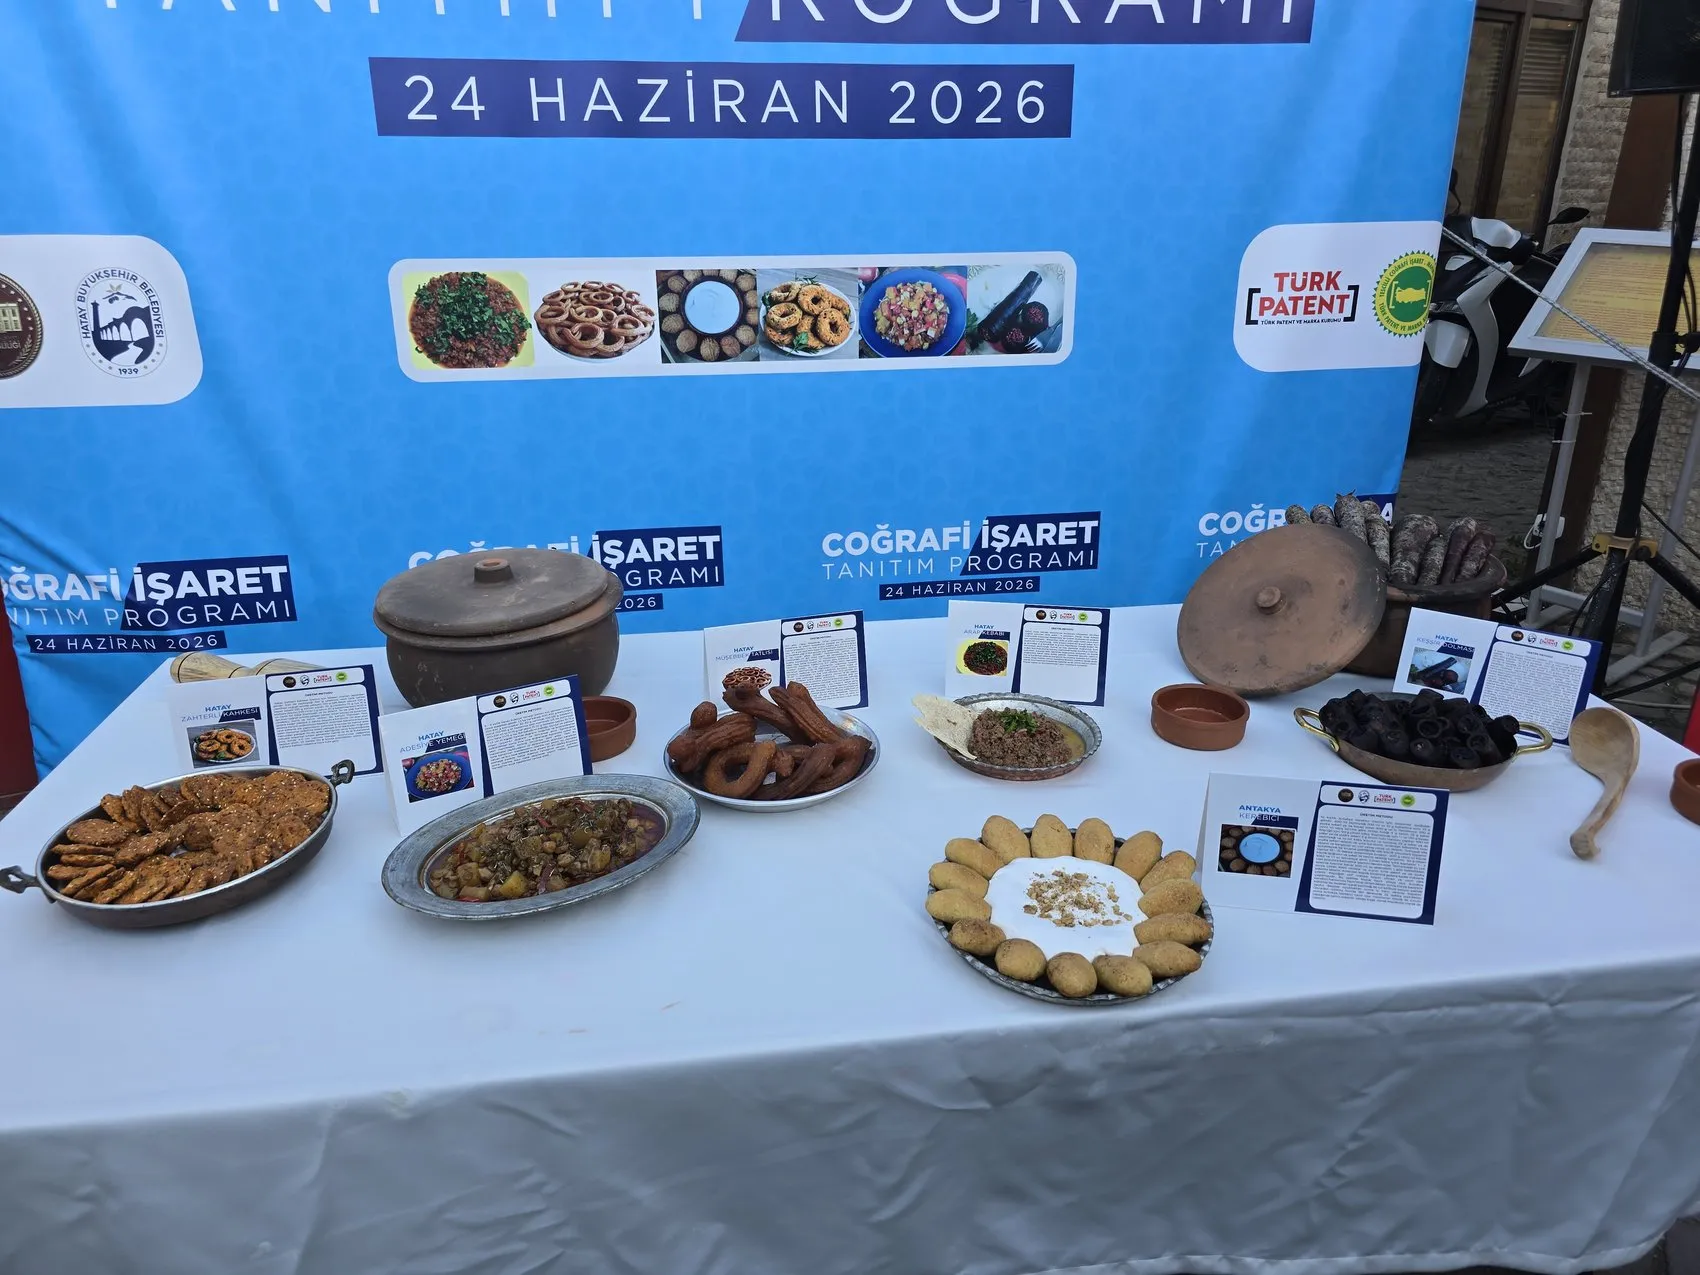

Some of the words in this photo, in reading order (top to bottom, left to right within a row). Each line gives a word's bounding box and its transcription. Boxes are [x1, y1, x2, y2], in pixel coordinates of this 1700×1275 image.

[404, 74, 486, 121] 24
[529, 70, 848, 123] HAZİRAN
[889, 80, 1045, 125] 2026
[1274, 270, 1342, 292] TÜRK
[1258, 294, 1350, 316] PATENT
[77, 306, 91, 339] HATAY
[118, 367, 139, 375] 1939
[822, 520, 971, 557] COĞRAFİ
[981, 519, 1099, 553] İŞARET
[591, 534, 721, 570] İŞARET
[822, 557, 935, 580] TANITIM
[950, 550, 1095, 577] PROGRAMI
[133, 565, 288, 606] İŞARET
[611, 566, 719, 587] GRAMI
[885, 586, 904, 598] 24
[912, 581, 987, 597] HAZİRAN
[995, 579, 1035, 592] 2026
[104, 599, 290, 627] PROGRAMI
[34, 638, 56, 651] 24
[67, 636, 157, 651] HAZİRAN
[166, 634, 218, 650] 2026
[205, 704, 232, 712] HATAY
[418, 730, 444, 742] HATAY
[1239, 804, 1281, 814] ANTAKYA
